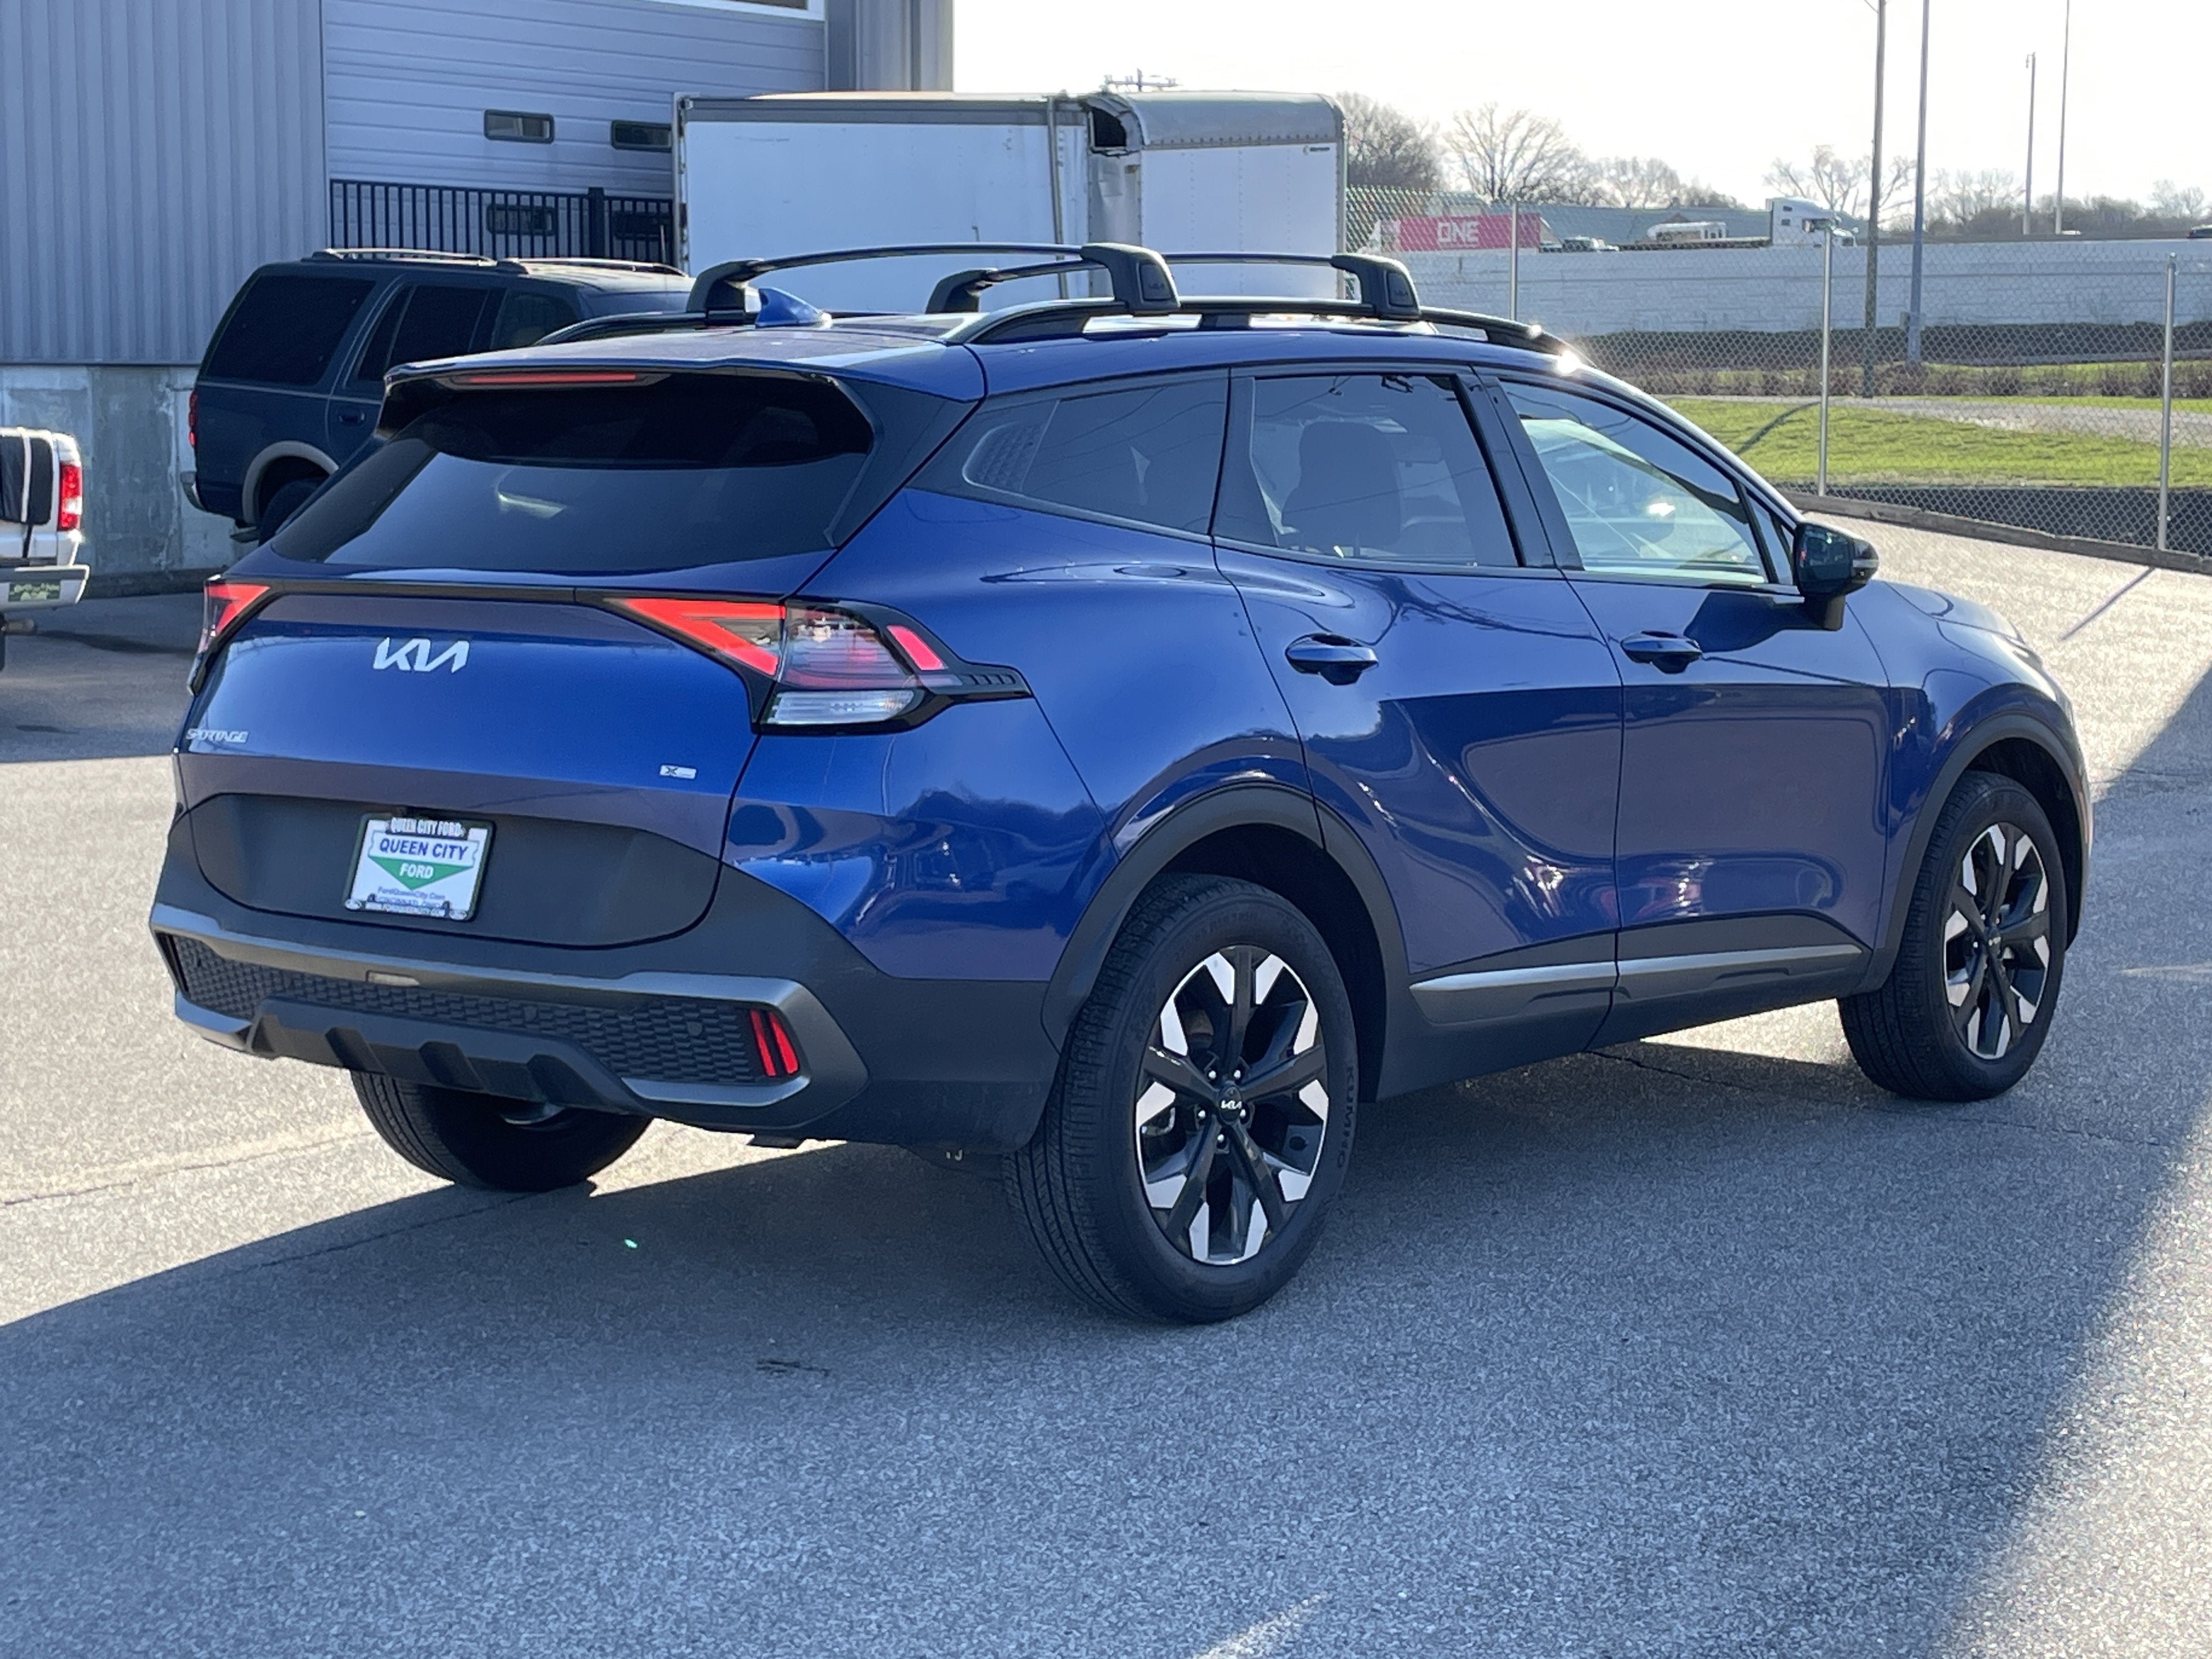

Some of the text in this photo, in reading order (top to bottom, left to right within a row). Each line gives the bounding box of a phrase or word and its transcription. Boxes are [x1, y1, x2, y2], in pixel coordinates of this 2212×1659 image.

[1437, 221, 1480, 242] ONE
[373, 637, 470, 673] KIA
[187, 729, 250, 743] SPORTAGE
[417, 820, 438, 835] CITY
[380, 838, 469, 860] QUEEN CITY
[399, 862, 434, 879] FORD
